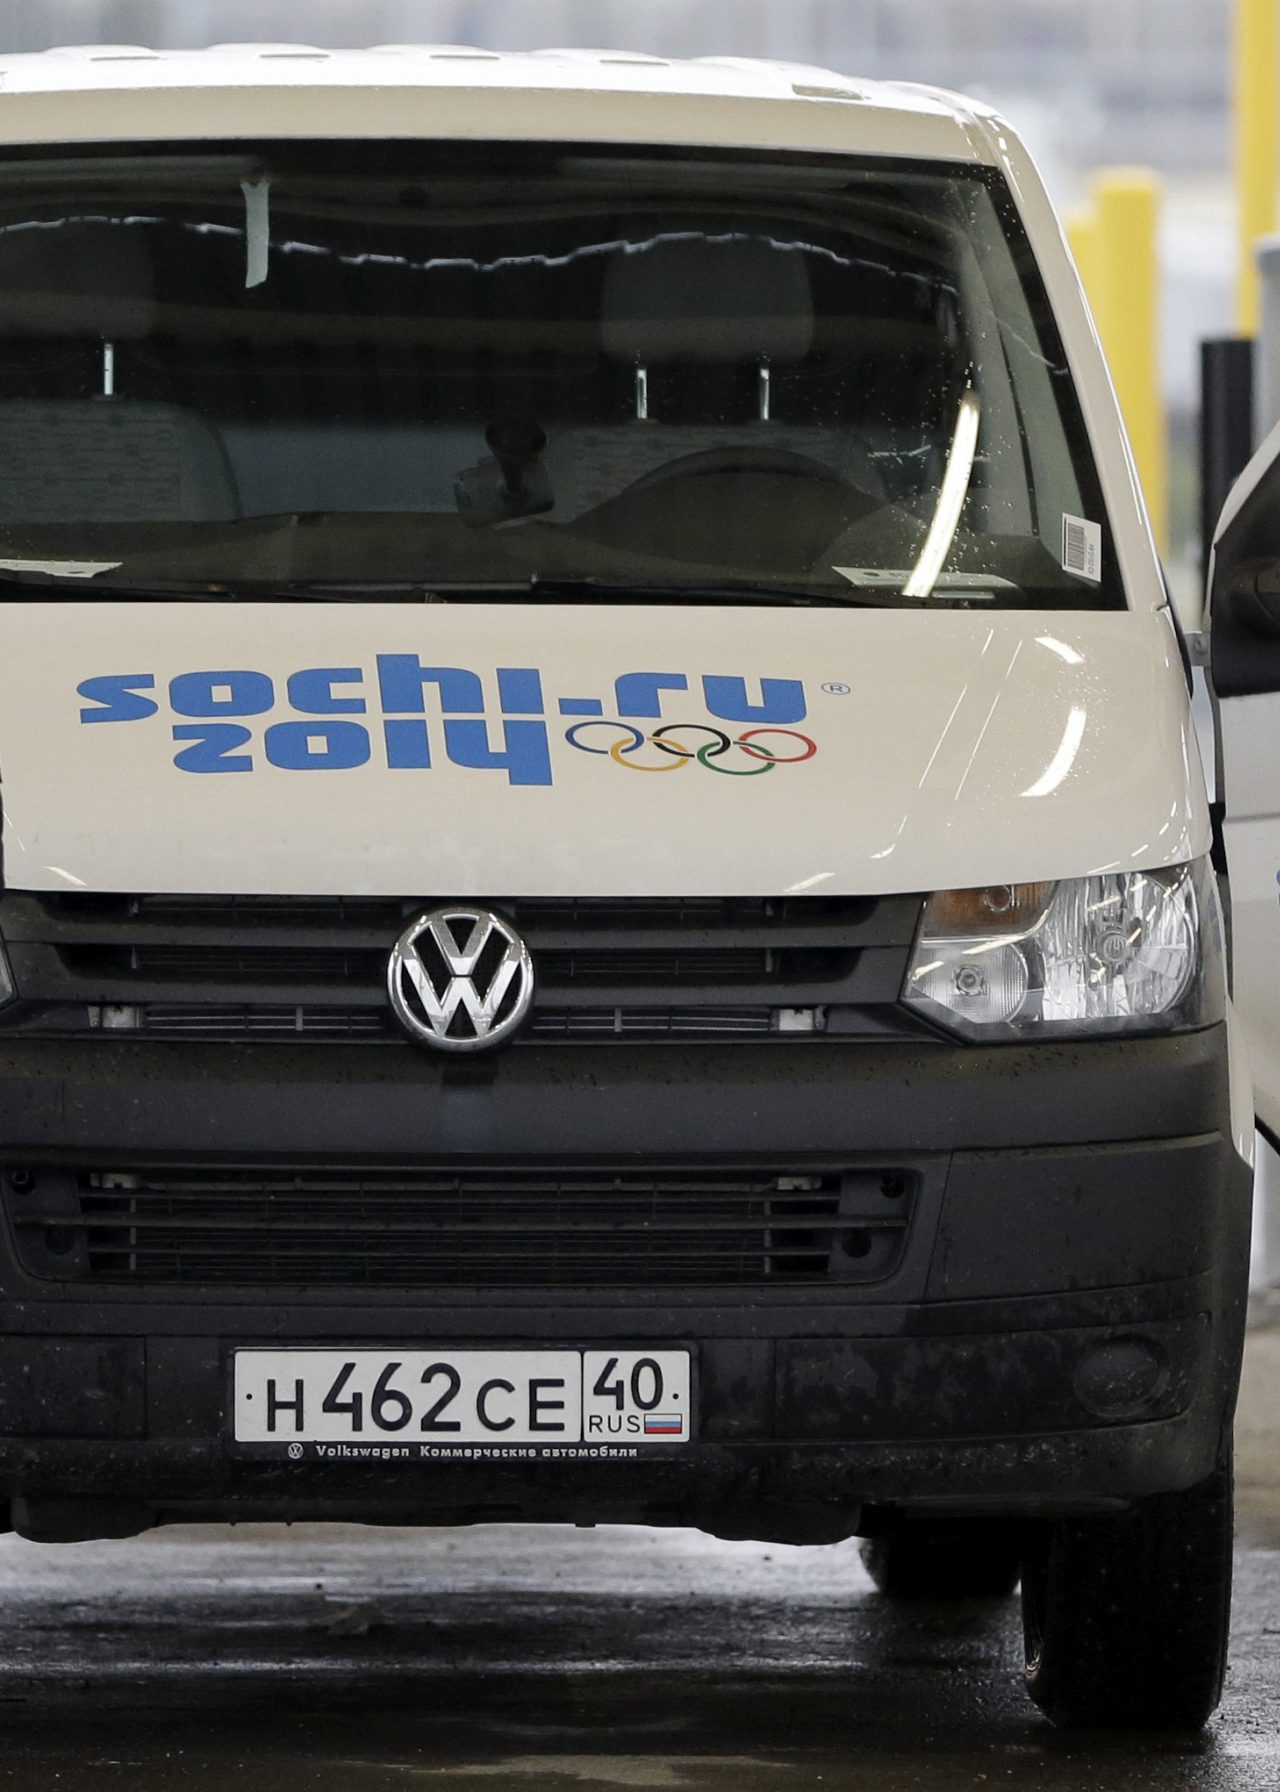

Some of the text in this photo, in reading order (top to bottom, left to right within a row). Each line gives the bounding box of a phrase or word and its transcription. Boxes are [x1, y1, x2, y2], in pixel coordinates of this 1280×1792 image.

[76, 653, 808, 724] sochi.ru
[172, 719, 553, 786] 2014
[593, 1358, 664, 1411] 40
[589, 1414, 641, 1434] RUS
[315, 1444, 410, 1459] Volkswagen
[419, 1445, 537, 1460] Коммерческие
[542, 1445, 638, 1458] автомобили
